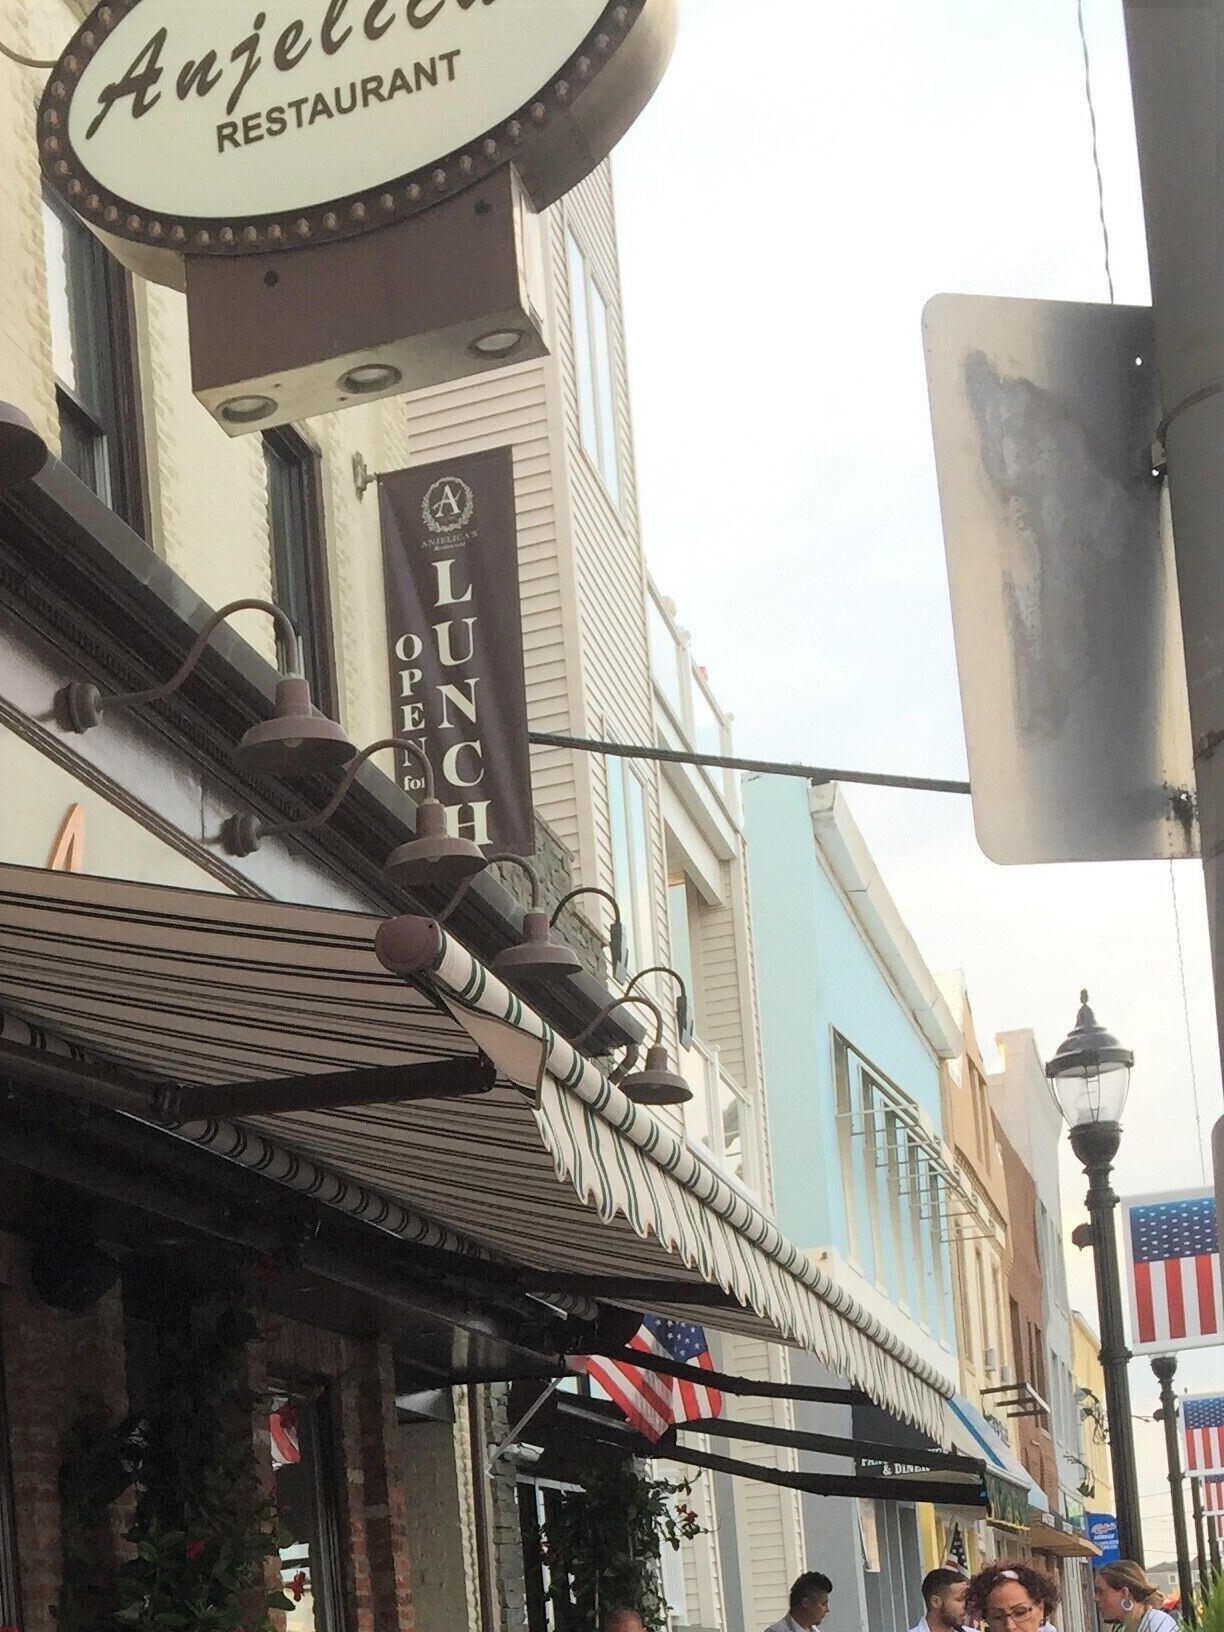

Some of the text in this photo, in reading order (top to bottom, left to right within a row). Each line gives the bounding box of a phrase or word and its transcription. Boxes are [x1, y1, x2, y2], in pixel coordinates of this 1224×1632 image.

[85, 0, 495, 141] Anjelic
[216, 49, 462, 153] RESTAURANT
[432, 484, 463, 517] A
[431, 558, 494, 846] LUNCH
